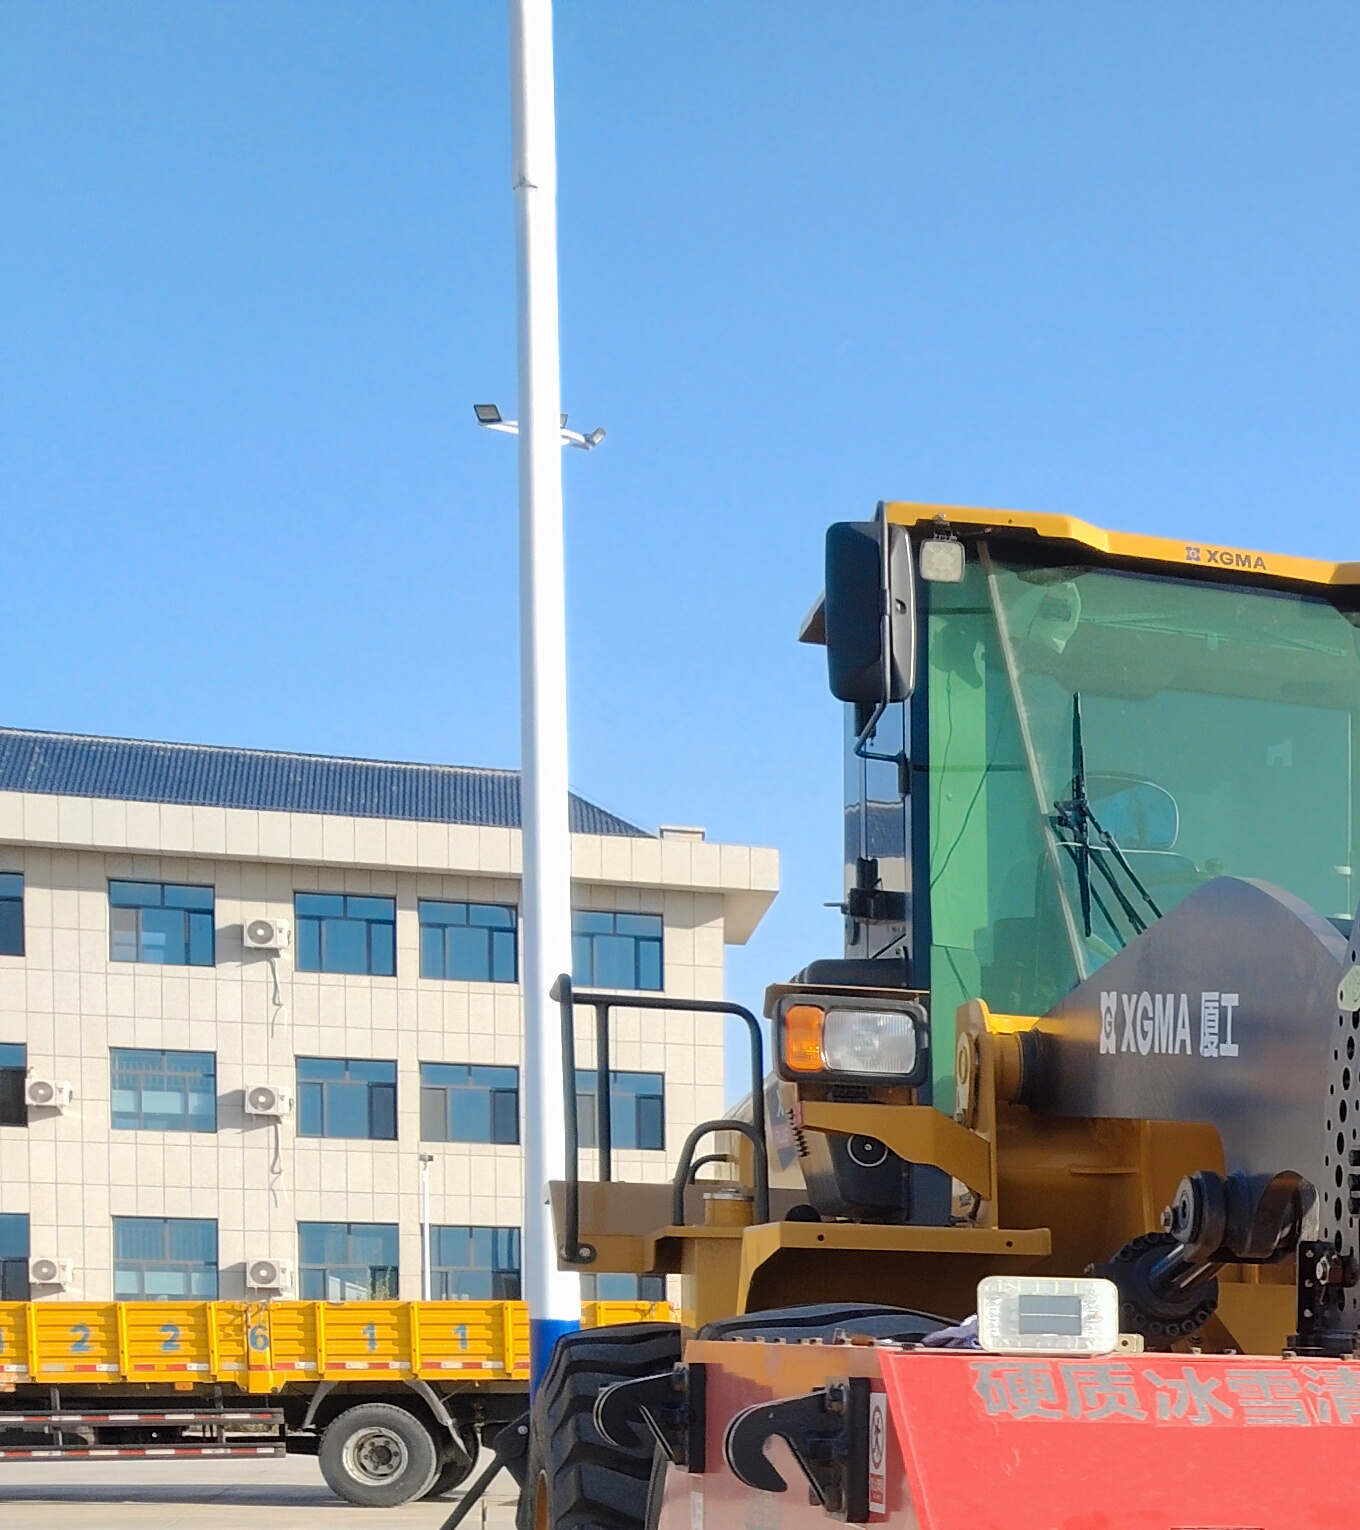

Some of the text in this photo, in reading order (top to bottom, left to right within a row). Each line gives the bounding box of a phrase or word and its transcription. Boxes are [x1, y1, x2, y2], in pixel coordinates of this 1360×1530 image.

[1206, 549, 1267, 571] XGMA
[1120, 991, 1239, 1057] XGMA 厦工
[69, 1320, 469, 1353] 2 2 6 1 1
